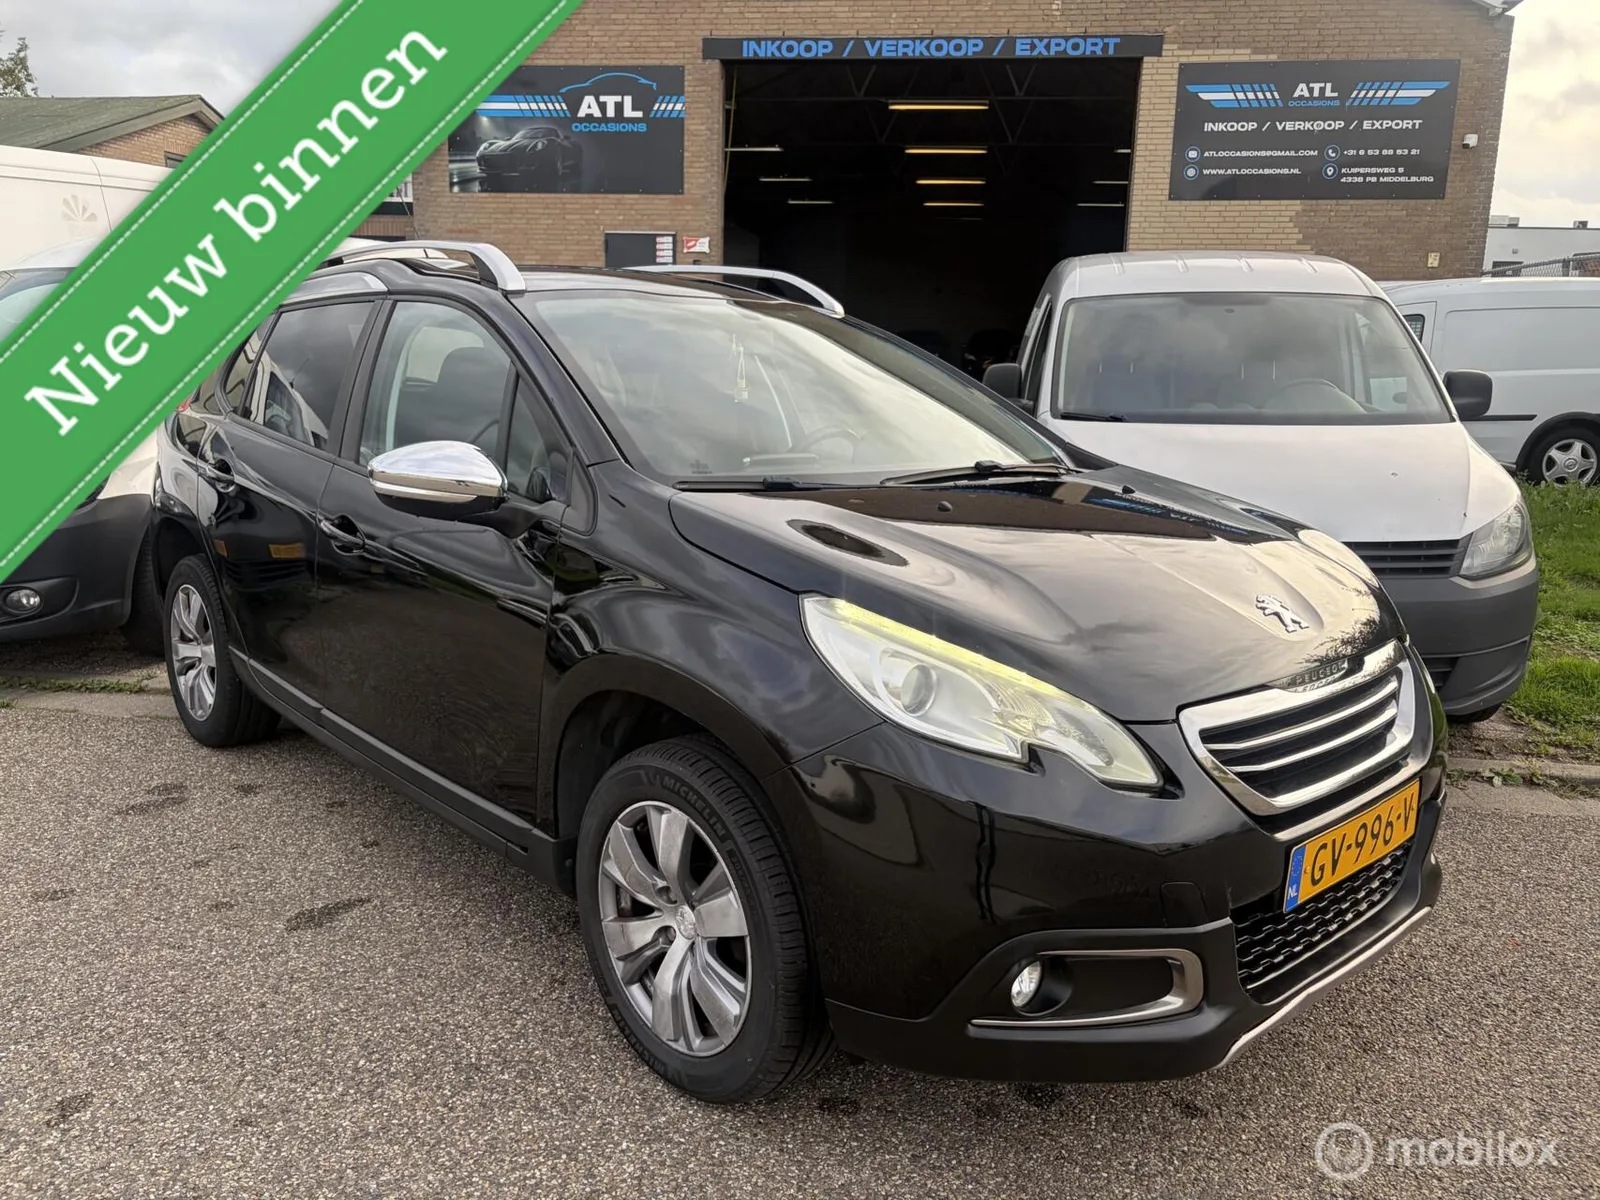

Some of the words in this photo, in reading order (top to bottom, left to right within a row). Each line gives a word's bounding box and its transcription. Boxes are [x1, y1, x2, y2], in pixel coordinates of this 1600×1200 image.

[742, 40, 833, 58] INKOOP
[842, 40, 855, 58] /
[863, 39, 984, 57] VERKOOP
[992, 38, 1006, 57] /
[1015, 38, 1121, 56] EXPORT
[1292, 82, 1339, 98] ATL
[576, 95, 644, 118] ATL
[571, 122, 647, 133] OCCASIONS
[1203, 122, 1258, 132] INKOOP
[1262, 121, 1271, 132] /
[1275, 121, 1345, 131] VERKOOP
[1349, 120, 1358, 131] /
[1362, 119, 1423, 130] EXPORT
[662, 776, 728, 838] MICHELIN
[1310, 792, 1415, 887] GV-996-V
[1287, 883, 1298, 900] NL
